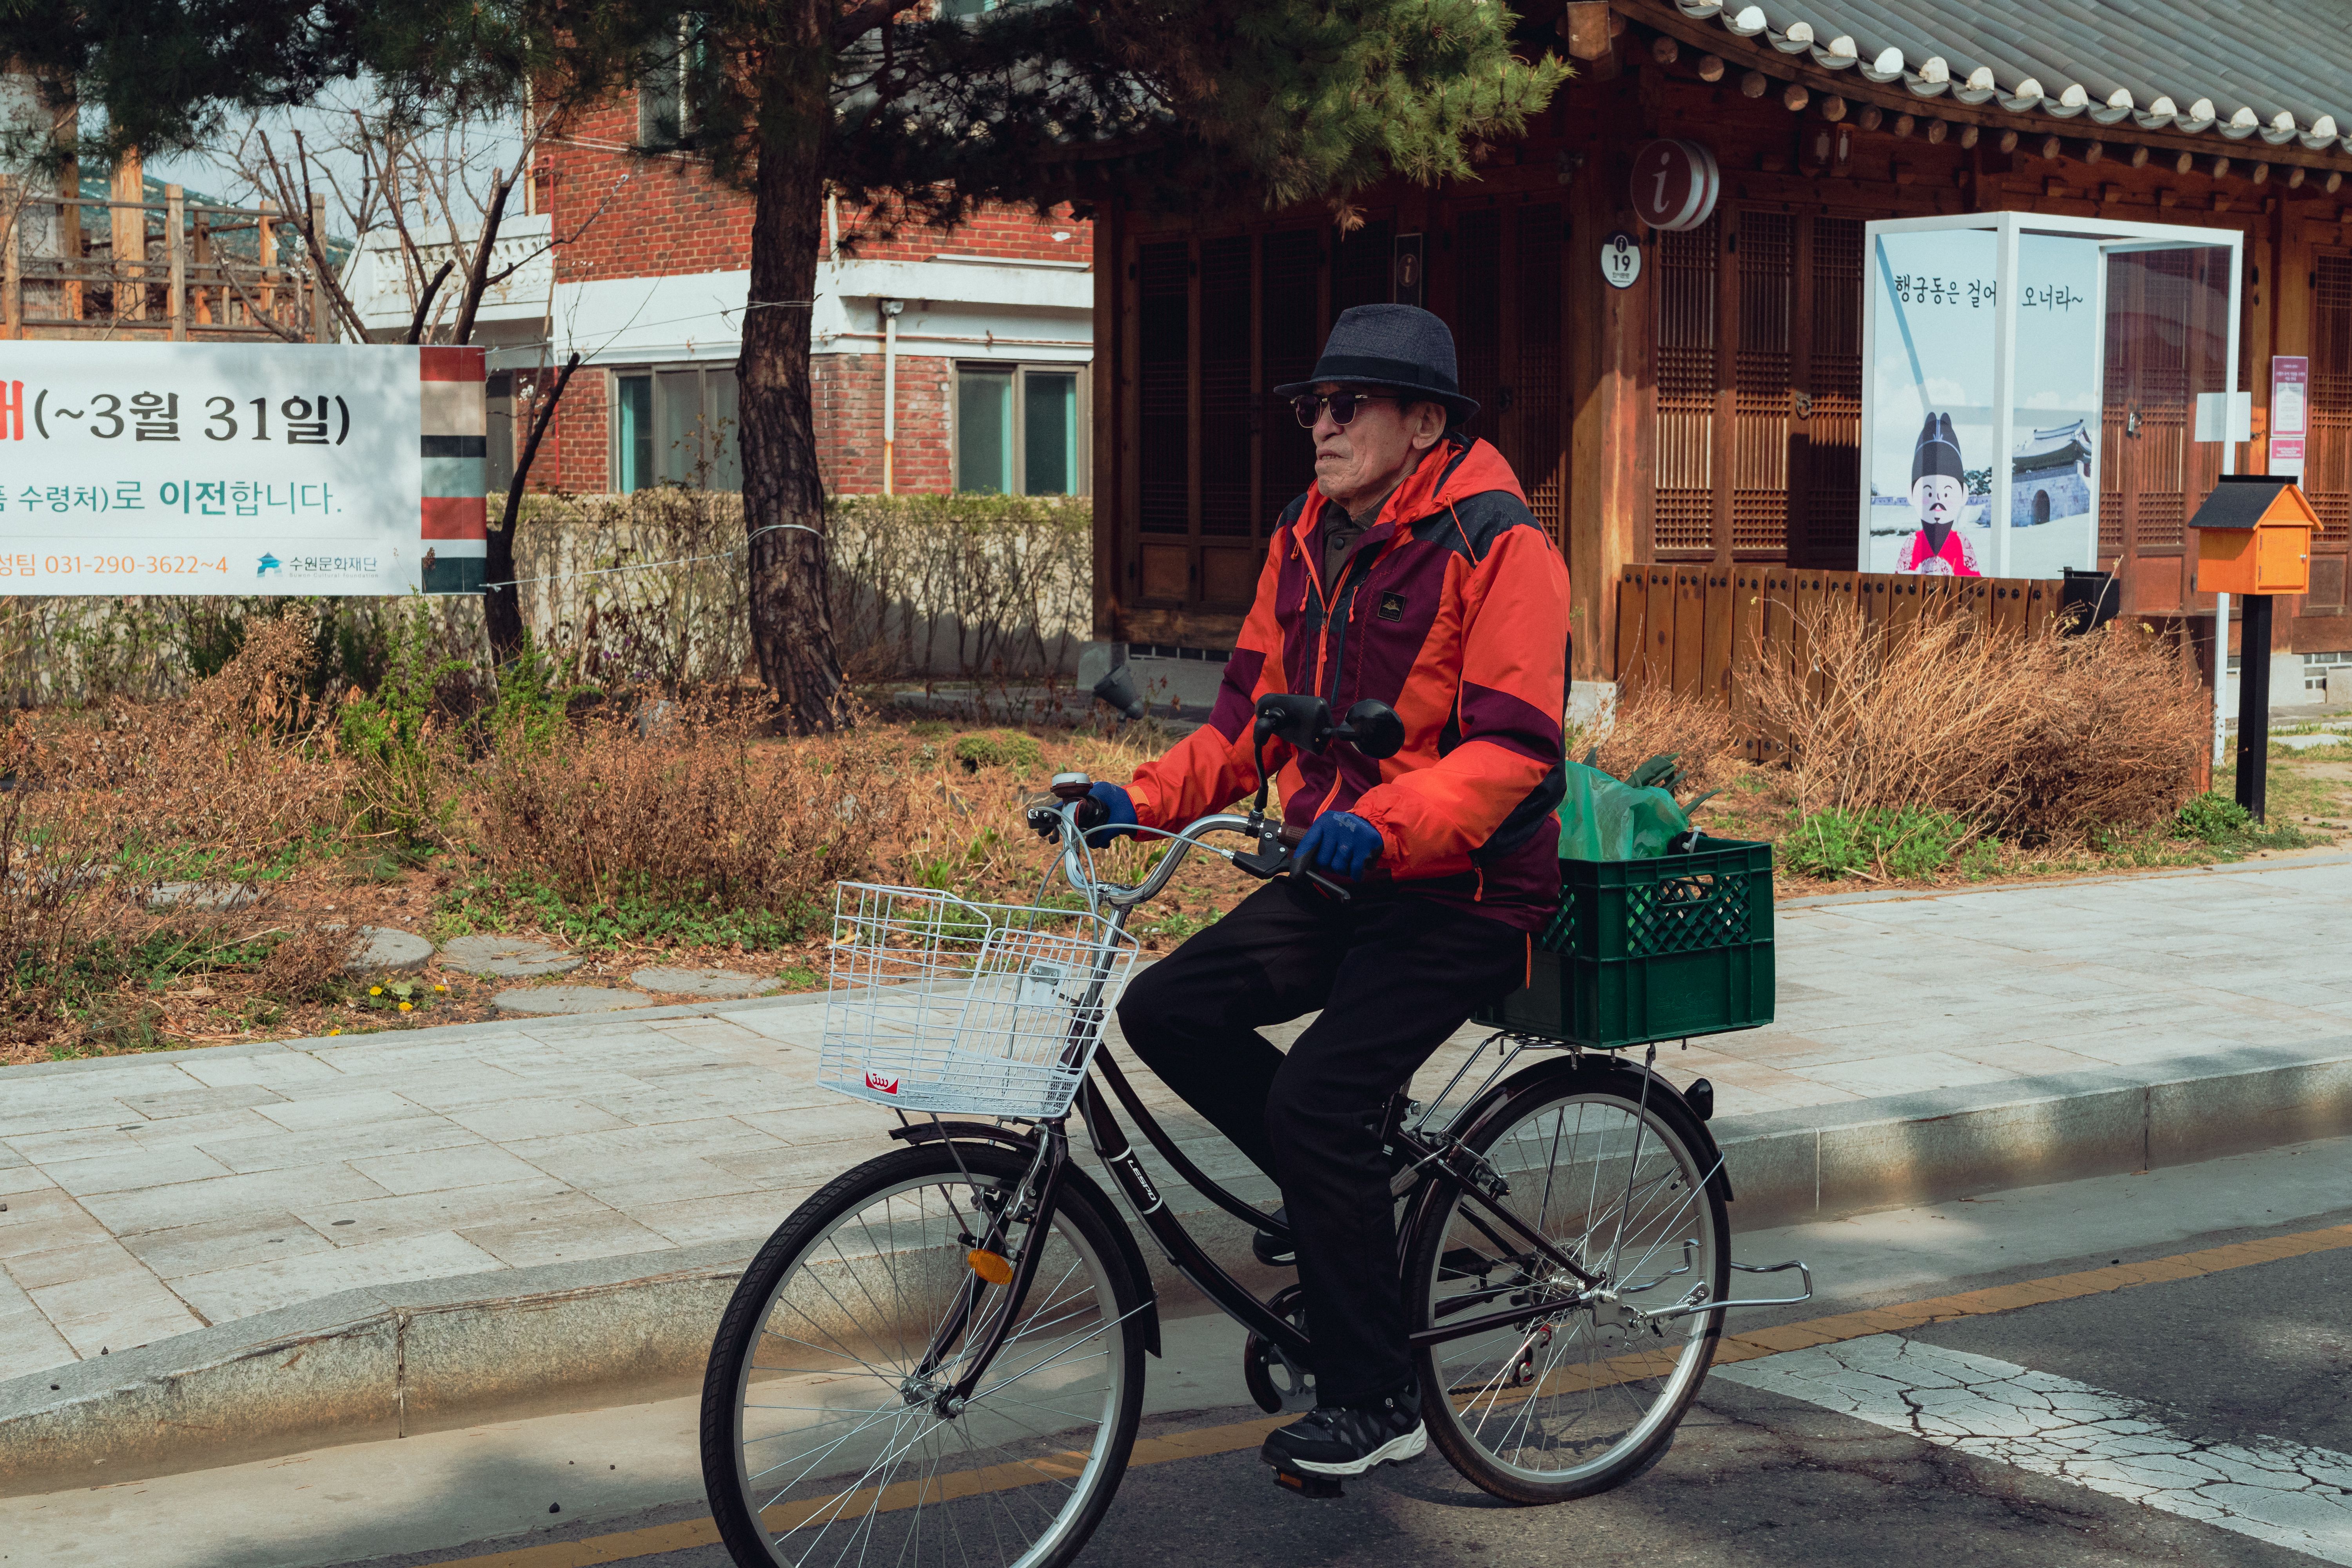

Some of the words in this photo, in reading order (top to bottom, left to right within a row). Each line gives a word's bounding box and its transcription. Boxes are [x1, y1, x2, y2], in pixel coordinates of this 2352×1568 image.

[1612, 255, 1630, 271] 19
[1894, 274, 1960, 305] 행궁동은
[1967, 279, 1996, 308] 걸어
[2022, 284, 2083, 312] 오너라~
[203, 394, 350, 446] 31일)
[18, 481, 145, 513] 수령처)로
[159, 480, 342, 516] 이전합니다.
[45, 555, 229, 574] 031-290-3622~4
[289, 557, 377, 571] 수원문화재단
[1127, 1160, 1157, 1201] LESPO
